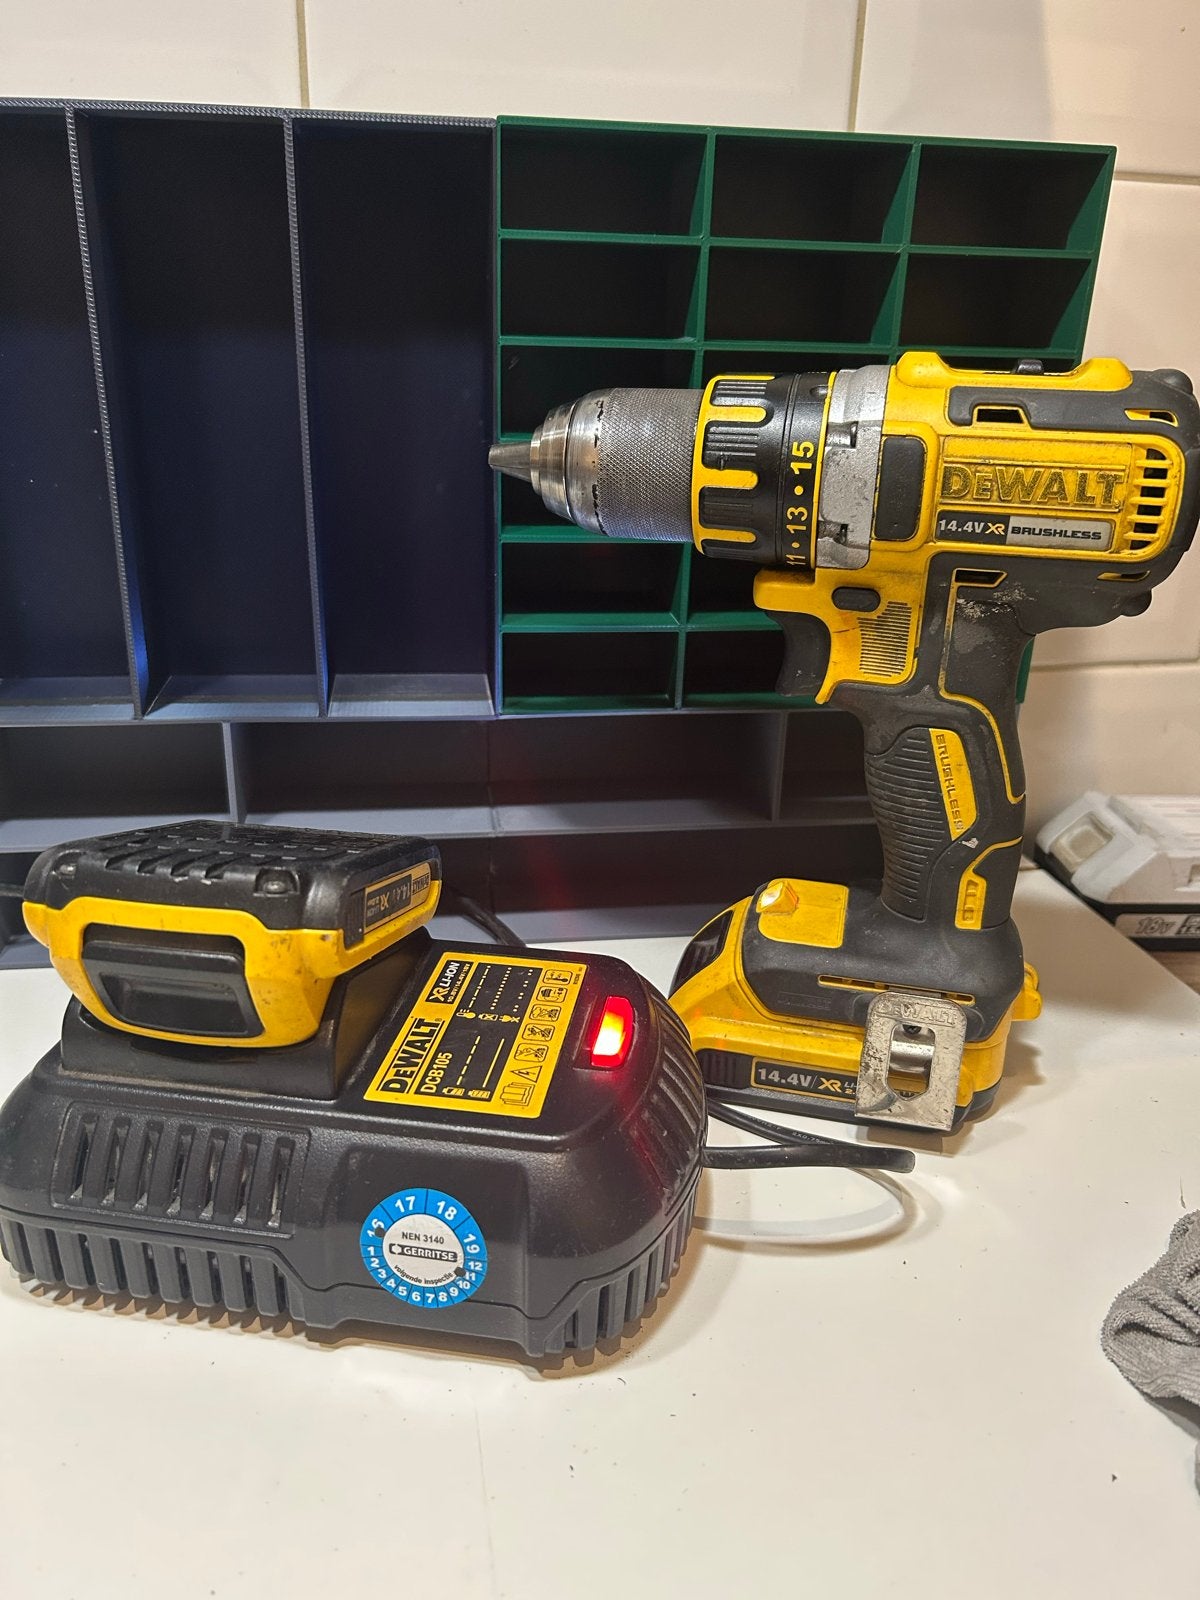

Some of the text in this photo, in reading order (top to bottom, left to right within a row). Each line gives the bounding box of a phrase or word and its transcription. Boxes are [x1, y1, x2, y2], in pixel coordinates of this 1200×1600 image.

[790, 441, 815, 475] 15
[941, 464, 1124, 507] DEWALT
[786, 506, 808, 534] 13
[939, 519, 1102, 540] 14.4V XR BRUSHLESS
[936, 734, 965, 830] BRUSHLESS
[429, 962, 460, 1002] XR LI-ION
[876, 1001, 960, 1026] DEWALT
[381, 1018, 443, 1093] DEWALT
[420, 1052, 453, 1094] DCB105
[817, 1077, 842, 1092] XR
[395, 1196, 416, 1213] 17
[437, 1201, 457, 1220] 18
[463, 1233, 480, 1254] 19
[402, 1231, 445, 1245] NEN 3140
[403, 1246, 455, 1261] GERRITSE
[368, 1247, 483, 1304] 1 2 3 4 5 6 7 8 9 10 11 12
[394, 1264, 454, 1286] volgende inspectie
